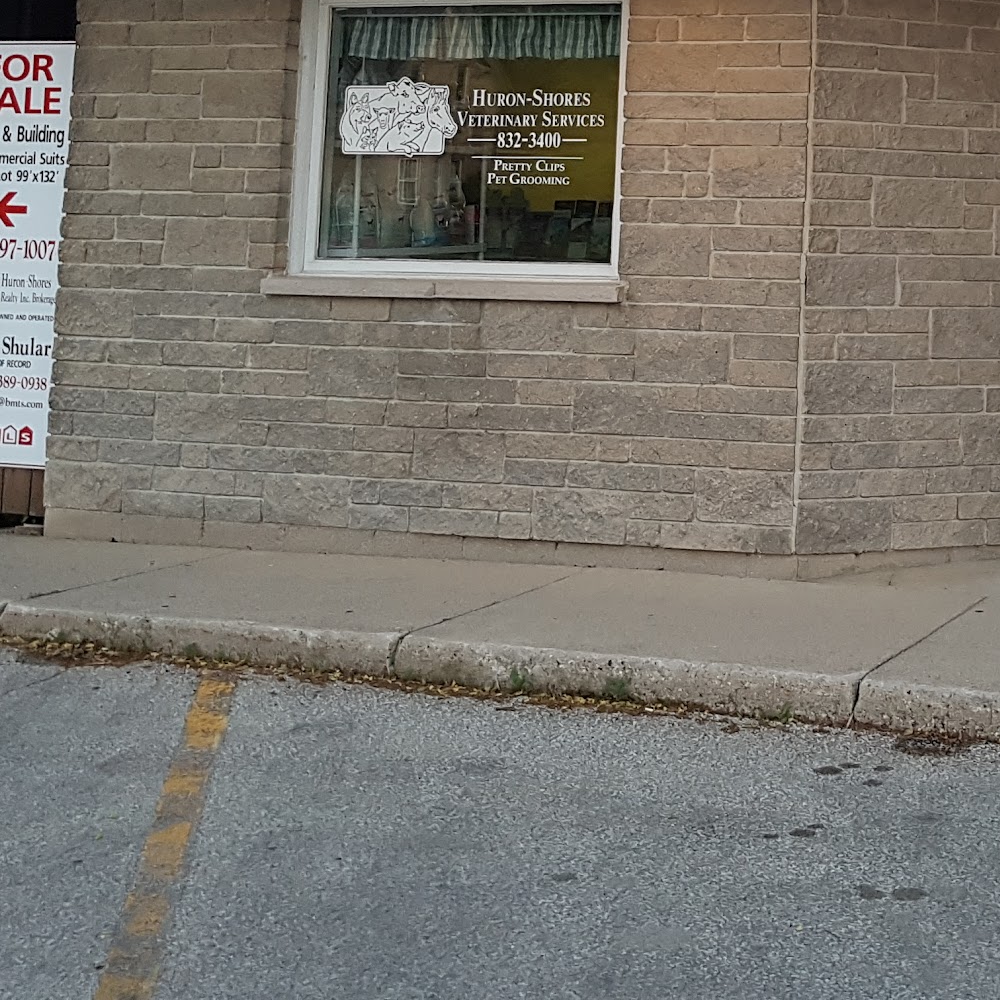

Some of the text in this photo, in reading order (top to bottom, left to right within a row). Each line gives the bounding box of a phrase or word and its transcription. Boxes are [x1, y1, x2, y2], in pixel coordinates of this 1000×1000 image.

[0, 54, 54, 82] OR
[0, 86, 62, 114] ALE
[472, 89, 591, 107] HURON-SHORES
[457, 110, 605, 127] VETERINARY SERVICES
[2, 123, 65, 148] & Building
[496, 131, 562, 148] 832-3400
[40, 152, 65, 165] Suits
[494, 160, 565, 172] PRETTY CLIPS
[0, 170, 12, 182] ot
[487, 172, 570, 185] PET GROOMING
[1, 292, 18, 304] Realty
[28, 314, 55, 322] OPERATED
[2, 336, 52, 356] Shular
[6, 359, 32, 369] RECORD
